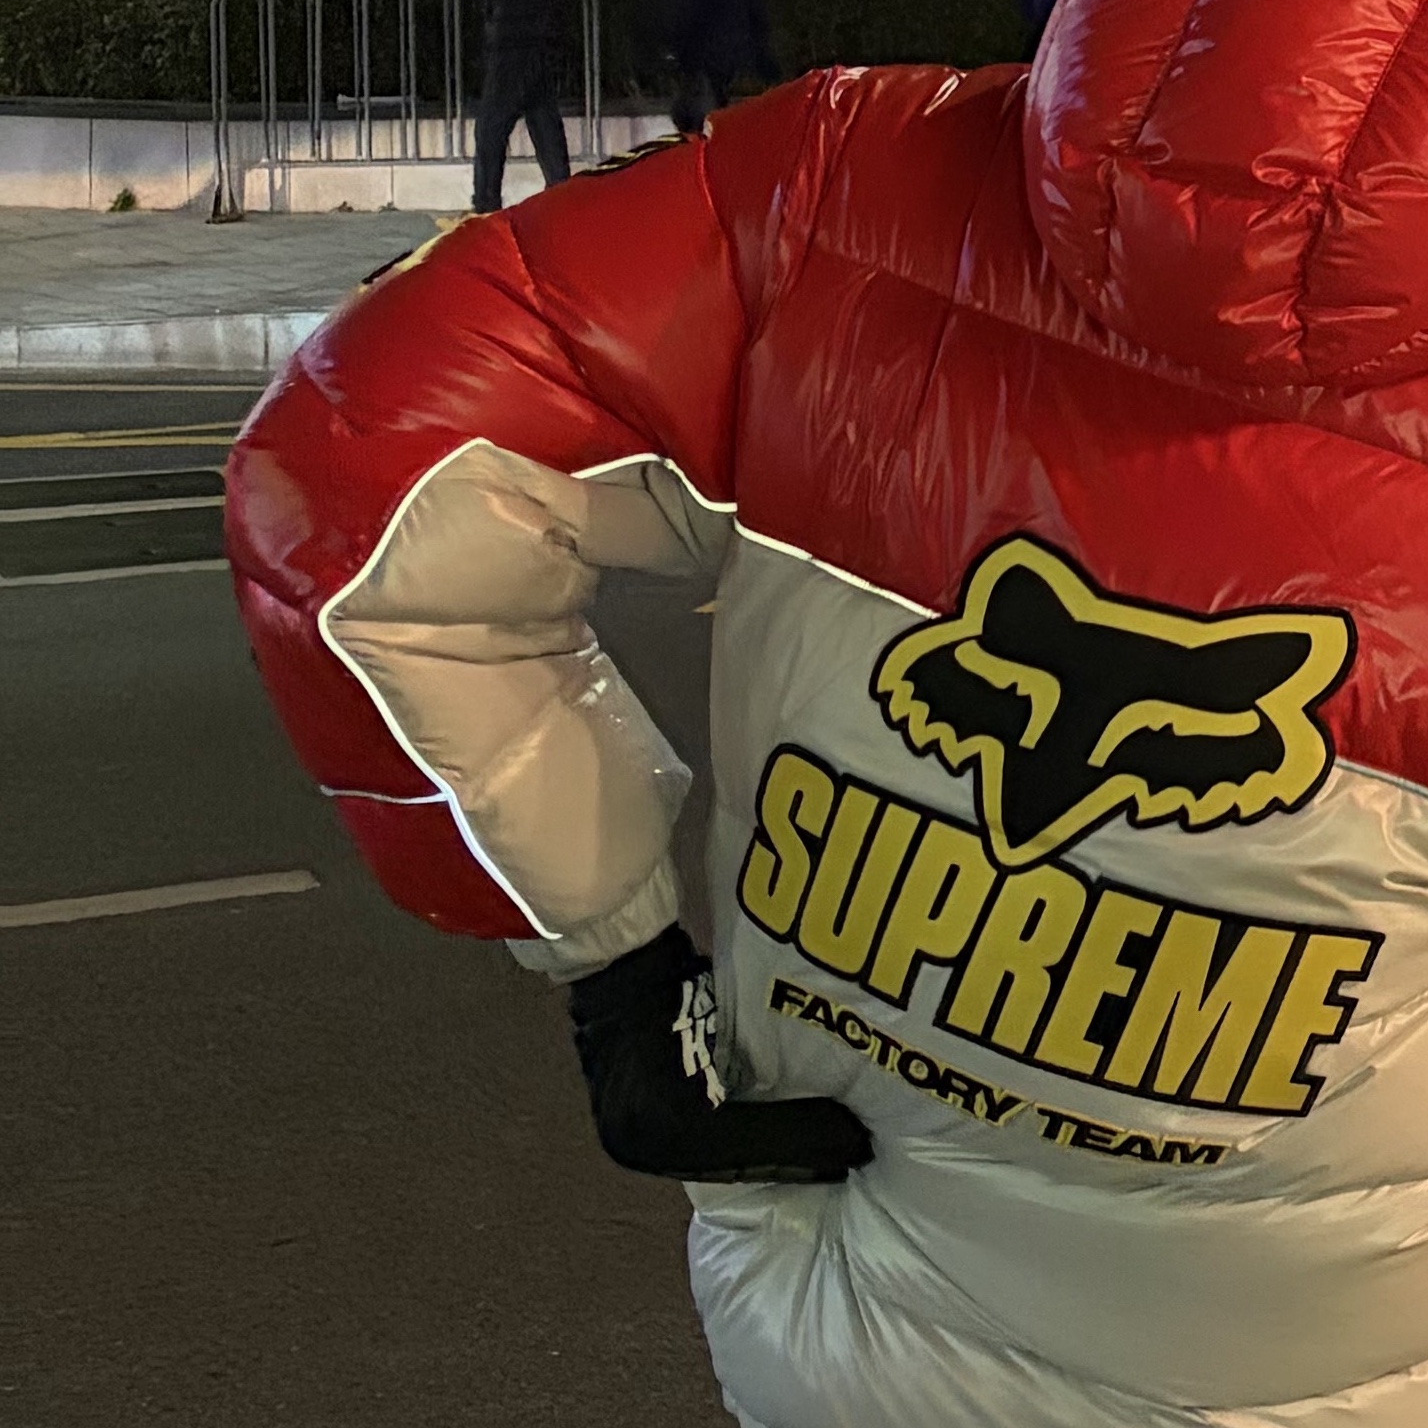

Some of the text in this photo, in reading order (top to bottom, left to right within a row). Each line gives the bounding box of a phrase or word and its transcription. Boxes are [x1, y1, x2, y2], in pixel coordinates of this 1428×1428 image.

[736, 743, 1385, 1117] SUPREME
[768, 978, 1231, 1165] FACTORY TEAM
